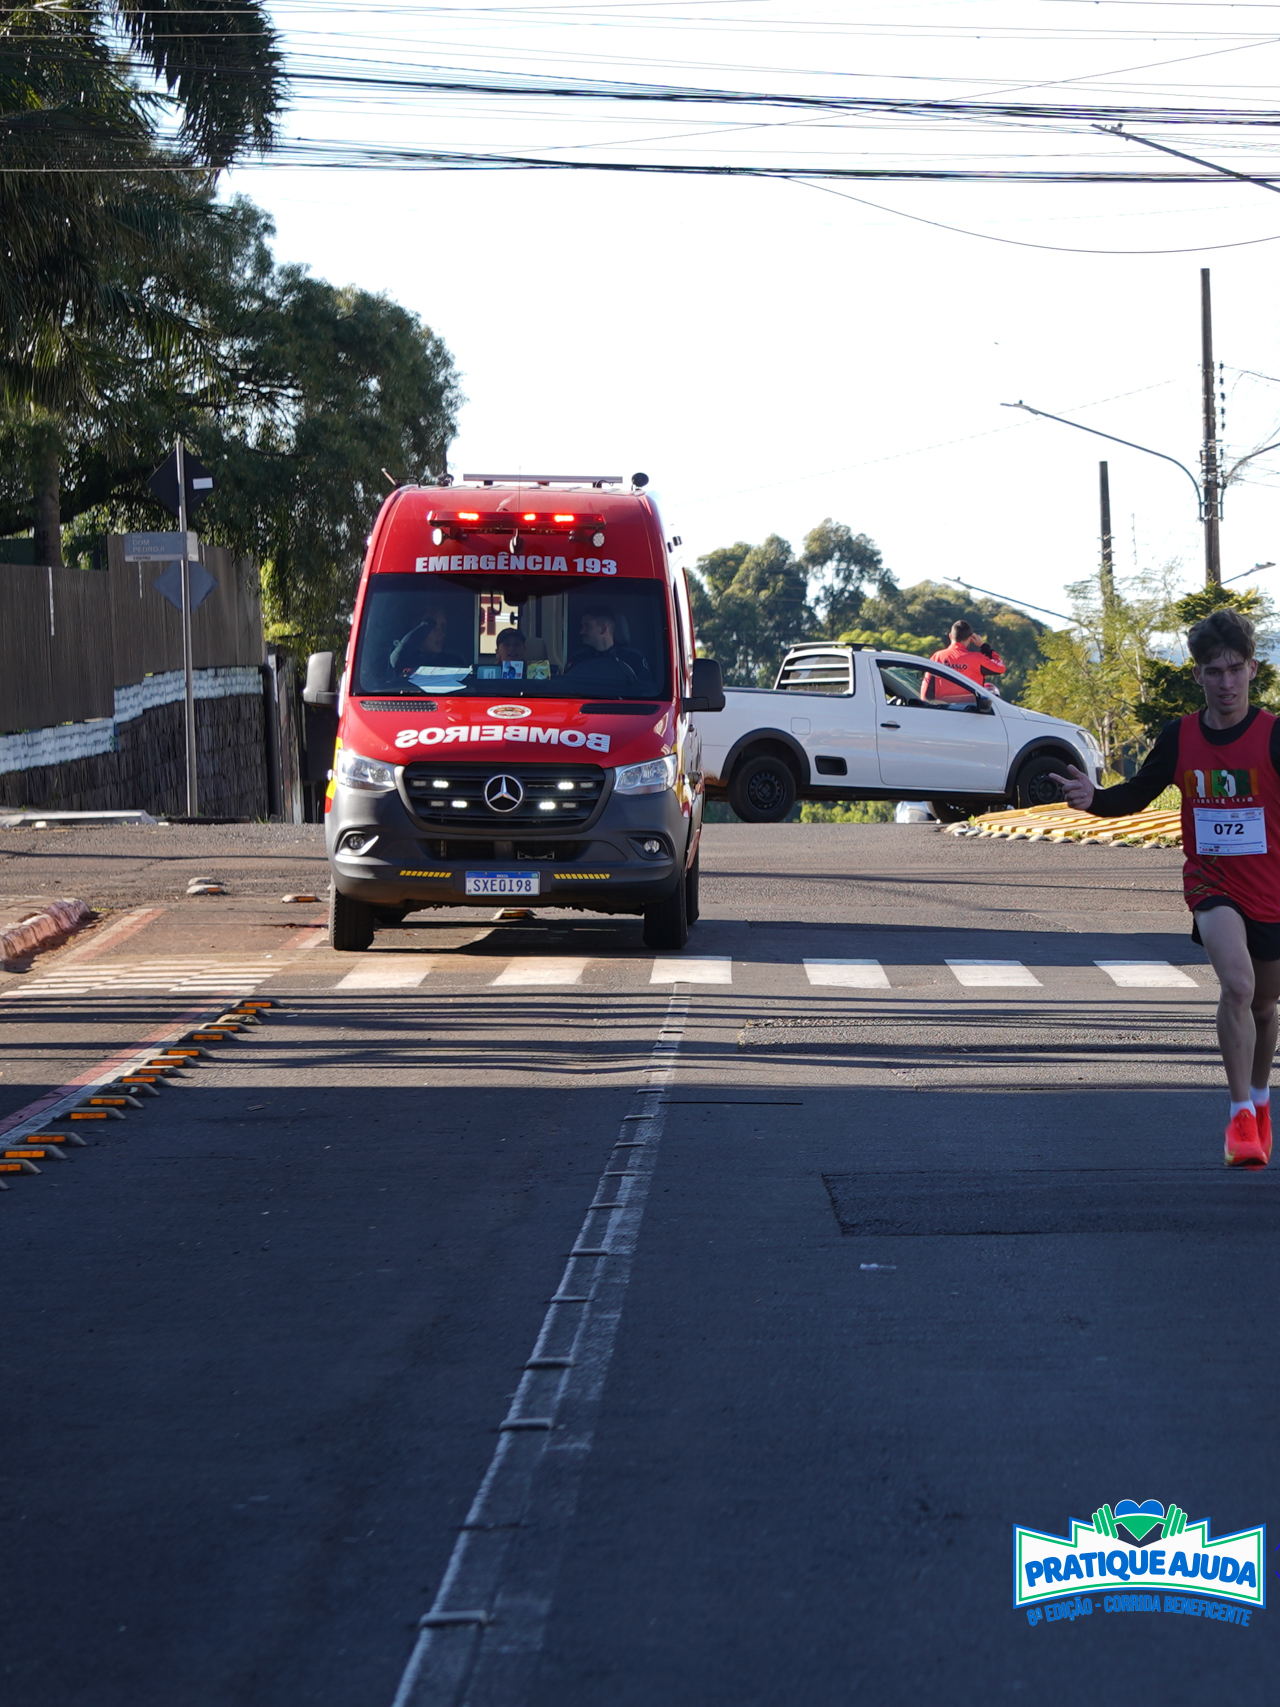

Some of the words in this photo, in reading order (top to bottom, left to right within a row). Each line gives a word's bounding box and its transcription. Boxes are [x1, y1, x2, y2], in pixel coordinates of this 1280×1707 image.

[415, 551, 568, 572] EMERGÊNCIA
[573, 557, 617, 575] 193
[1184, 769, 1259, 798] NAIROBI
[1214, 823, 1244, 835] 072
